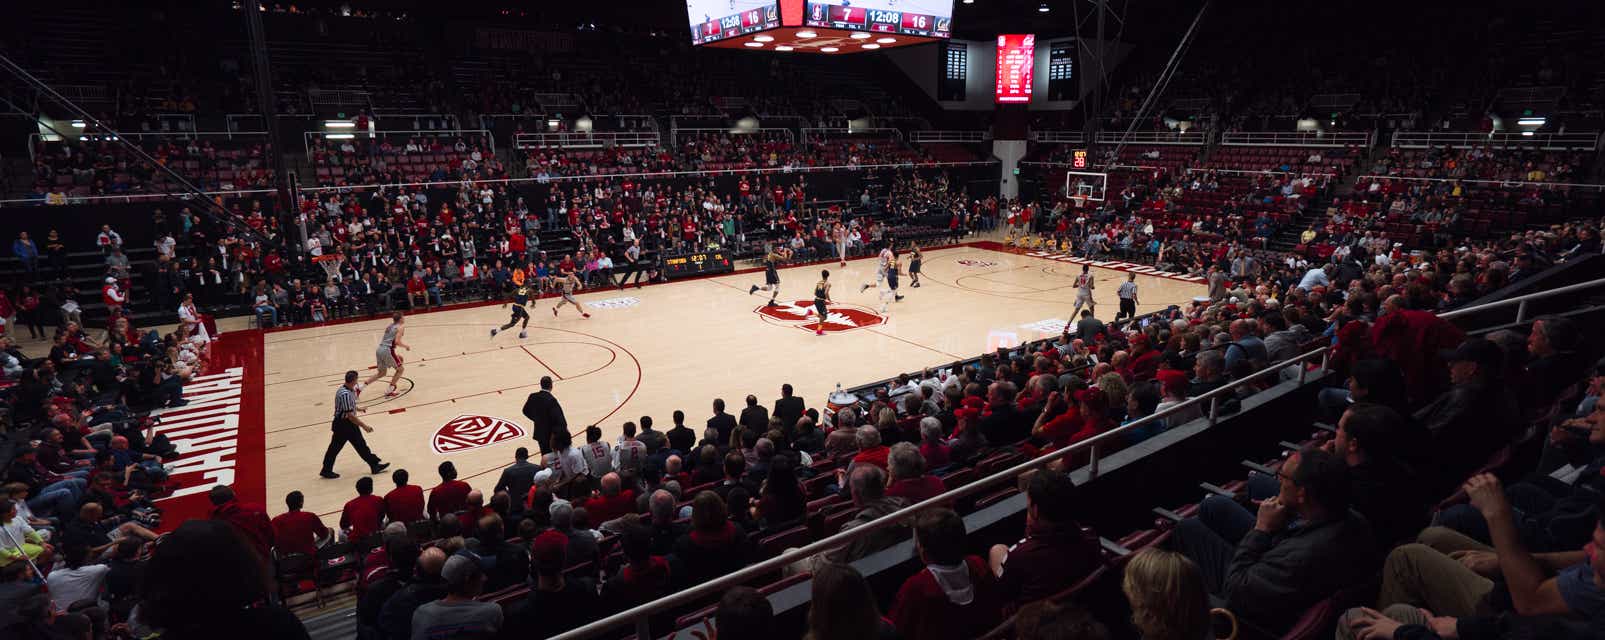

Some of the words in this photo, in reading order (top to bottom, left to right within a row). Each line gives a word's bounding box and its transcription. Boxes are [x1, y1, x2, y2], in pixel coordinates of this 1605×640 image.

[721, 14, 741, 29] 12:08
[749, 11, 759, 25] 16
[843, 7, 852, 21] 7
[870, 10, 899, 24] 12:08
[912, 15, 926, 28] 16
[1074, 157, 1085, 168] 28
[142, 367, 243, 503] CARDINAL
[592, 446, 605, 459] 15
